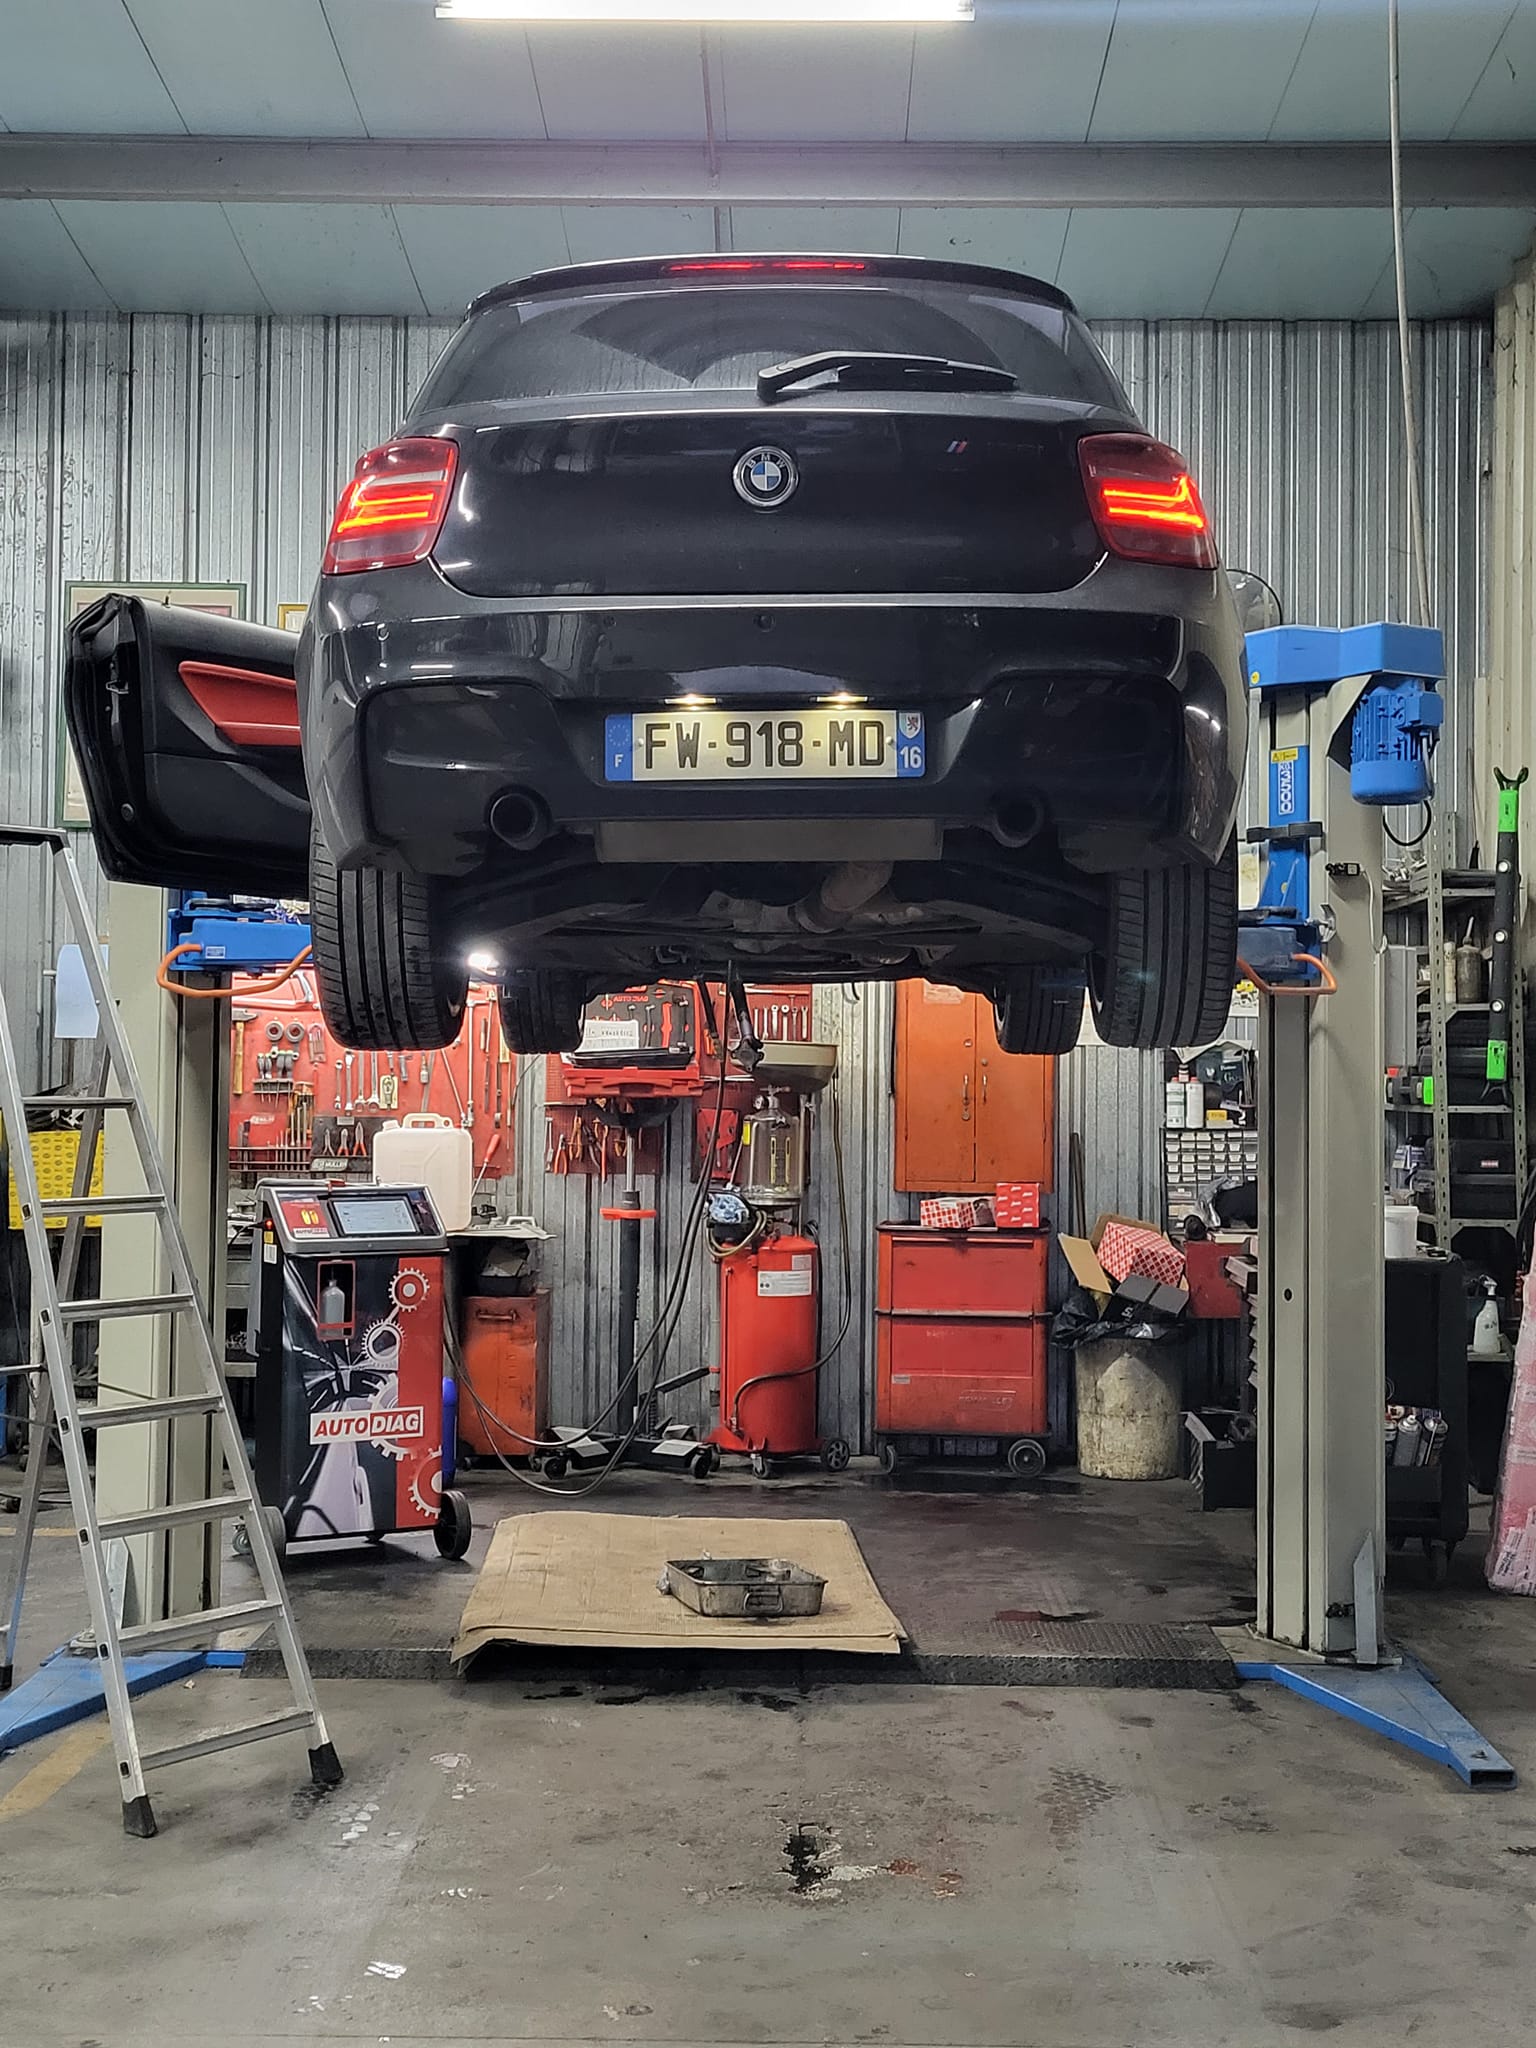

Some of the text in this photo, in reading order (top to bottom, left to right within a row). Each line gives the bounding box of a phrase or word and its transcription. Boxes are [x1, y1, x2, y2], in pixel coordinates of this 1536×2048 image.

[747, 453, 786, 469] BMW
[645, 720, 885, 769] FW-918-MD
[614, 754, 624, 768] F
[900, 746, 922, 769] 16
[314, 1413, 419, 1437] AUTODIAG
